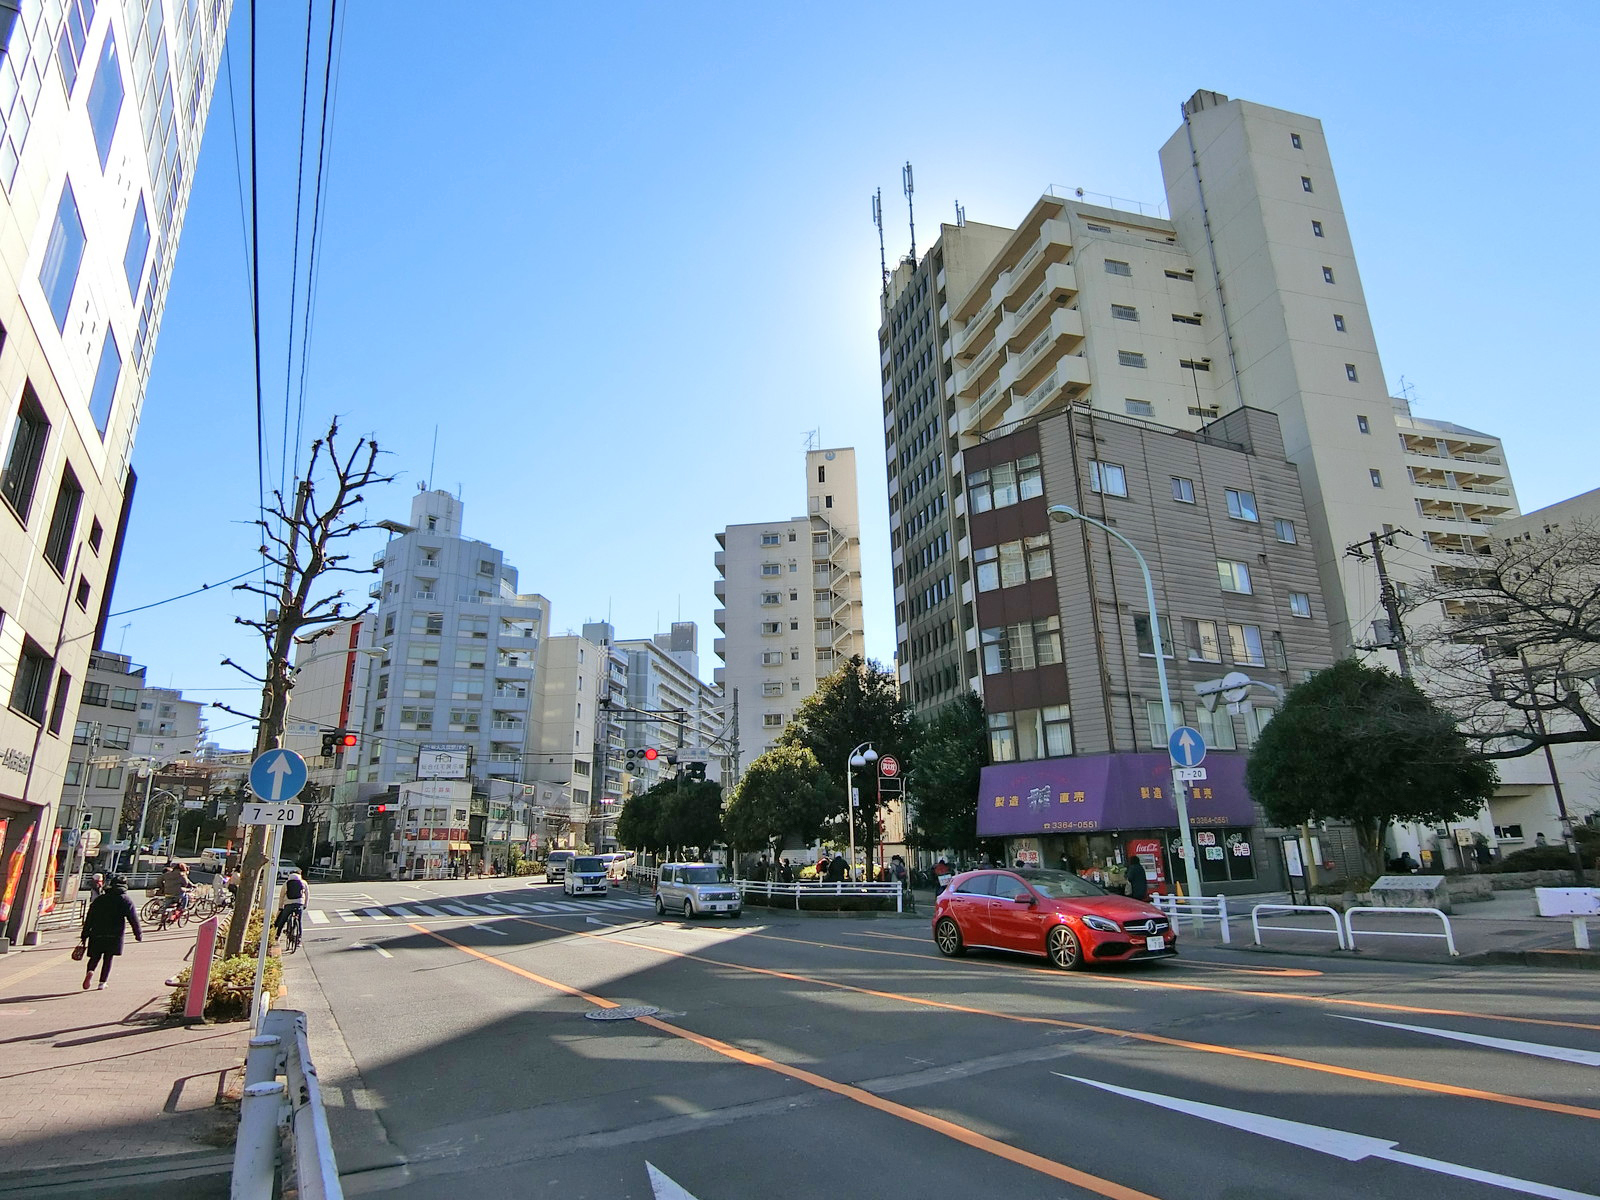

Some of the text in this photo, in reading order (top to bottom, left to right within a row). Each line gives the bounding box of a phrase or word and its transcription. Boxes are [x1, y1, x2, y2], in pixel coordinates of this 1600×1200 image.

[1180, 770, 1202, 778] 7-20
[1140, 787, 1213, 799] 製造 直売
[994, 795, 1019, 808] 製造
[1060, 791, 1085, 803] 直売
[253, 808, 295, 821] 7-20
[1052, 821, 1098, 829] 3364-0551
[1198, 832, 1215, 845] 果物
[1206, 847, 1223, 859] 野菜
[1233, 843, 1250, 856] 弁当
